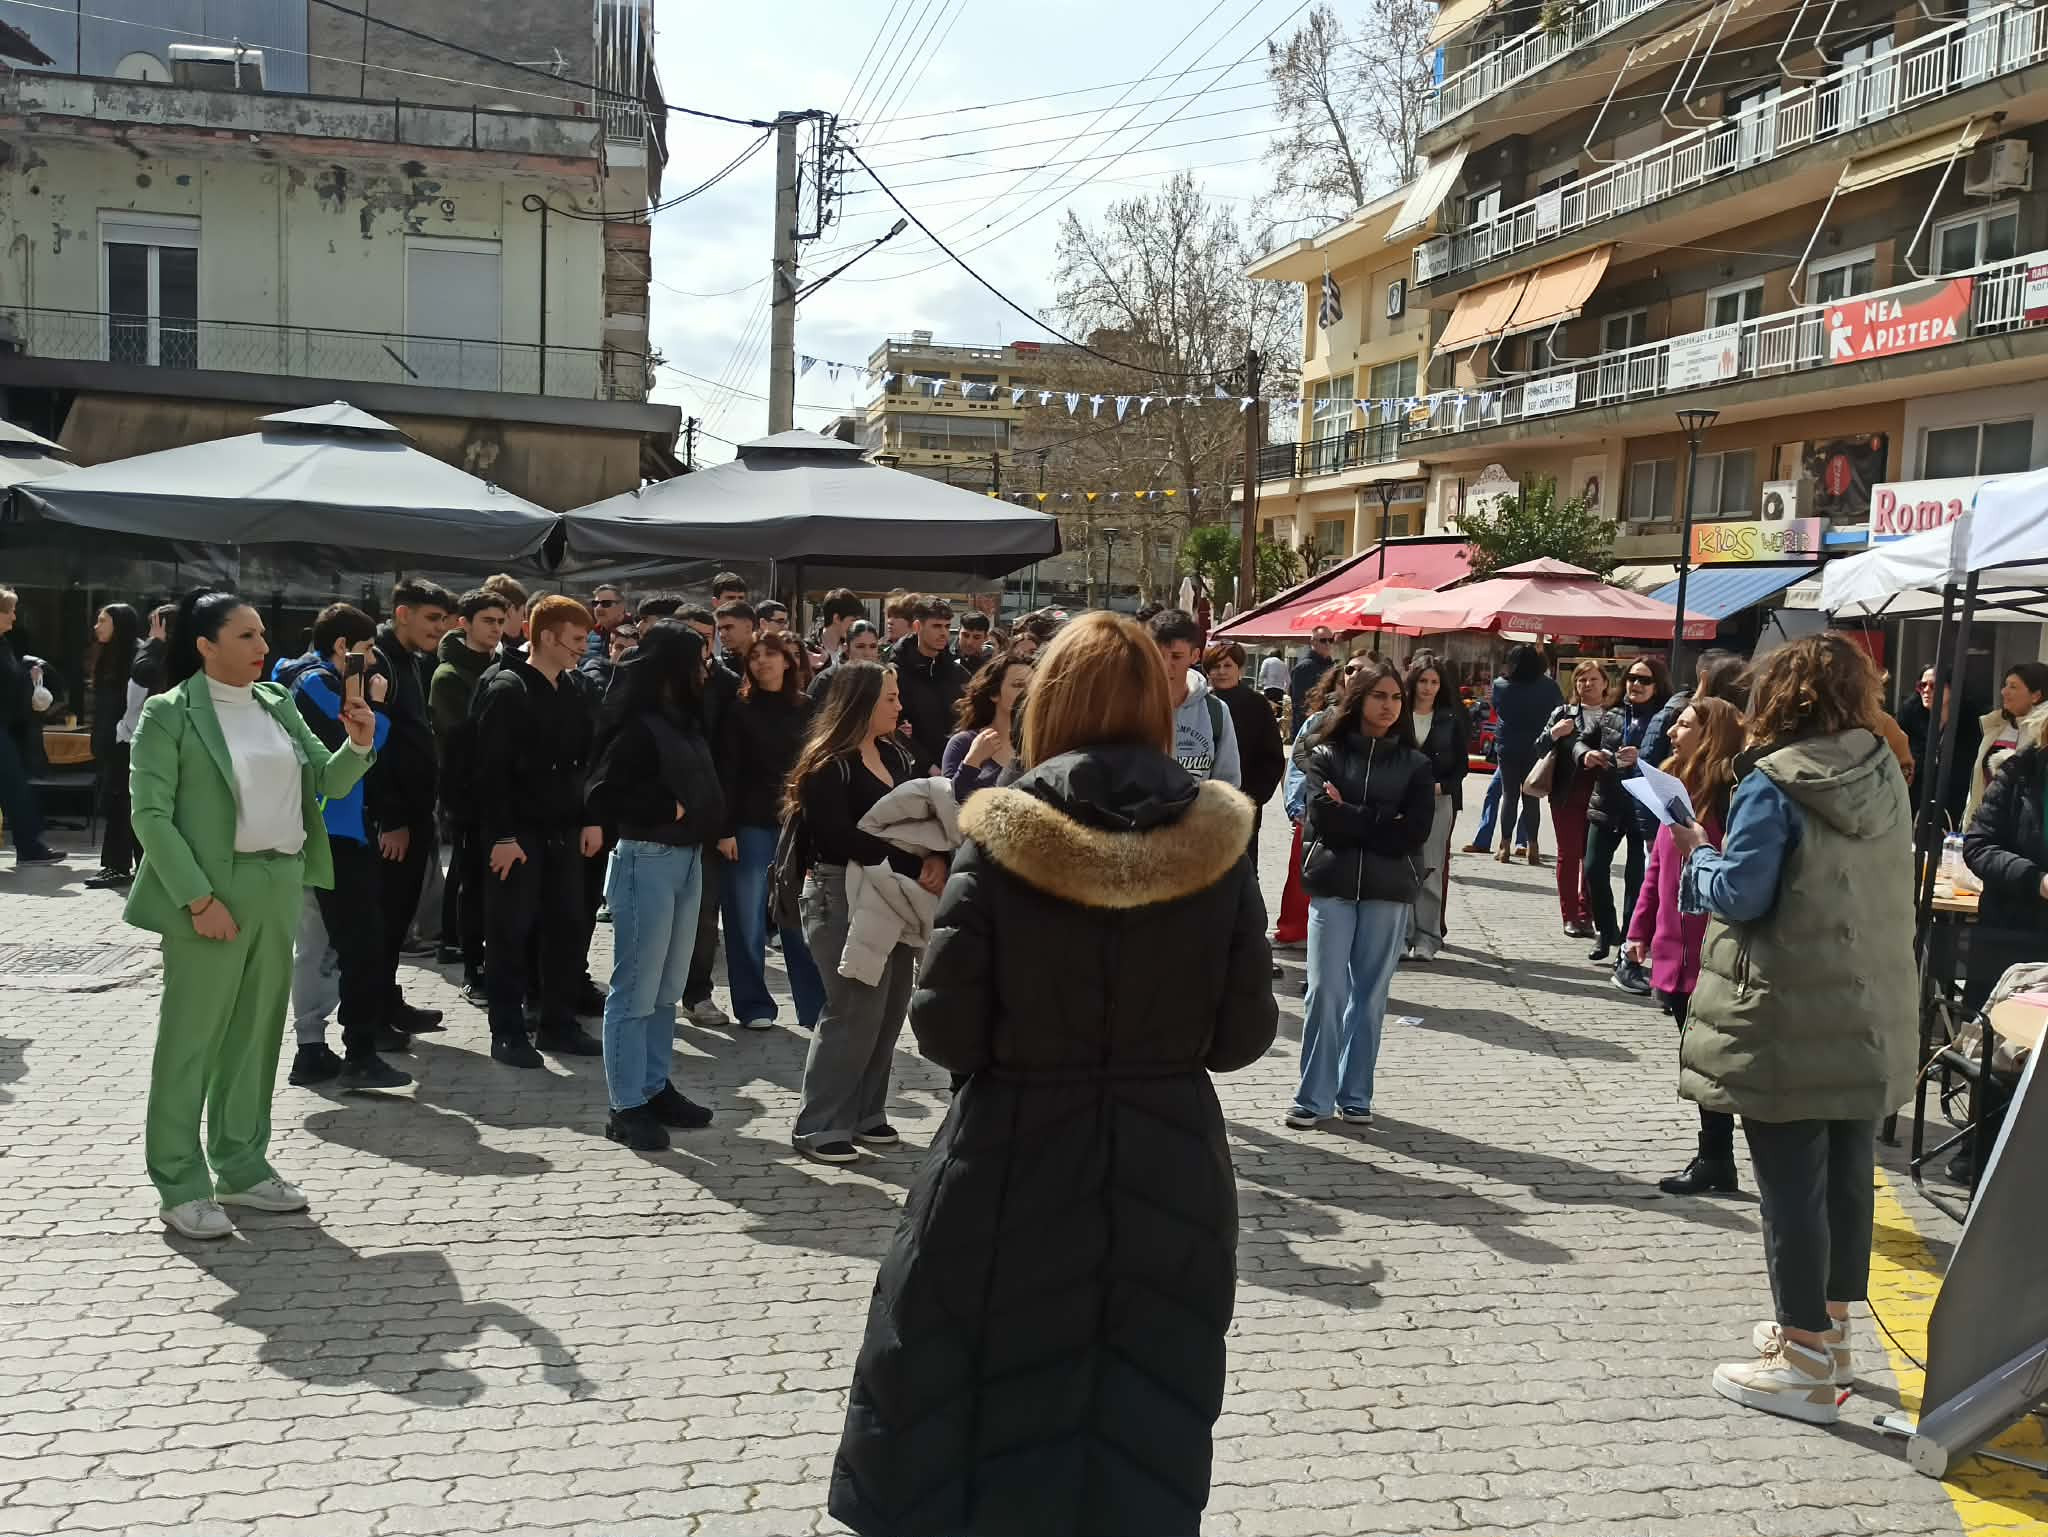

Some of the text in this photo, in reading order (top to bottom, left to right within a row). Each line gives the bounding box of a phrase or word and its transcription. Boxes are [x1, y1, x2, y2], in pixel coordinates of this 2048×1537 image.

[1865, 299, 1903, 325] ΝΕΑ
[1861, 316, 1957, 354] ΑΡΙΣΤΕΡΑ
[1874, 489, 1963, 534] Roma
